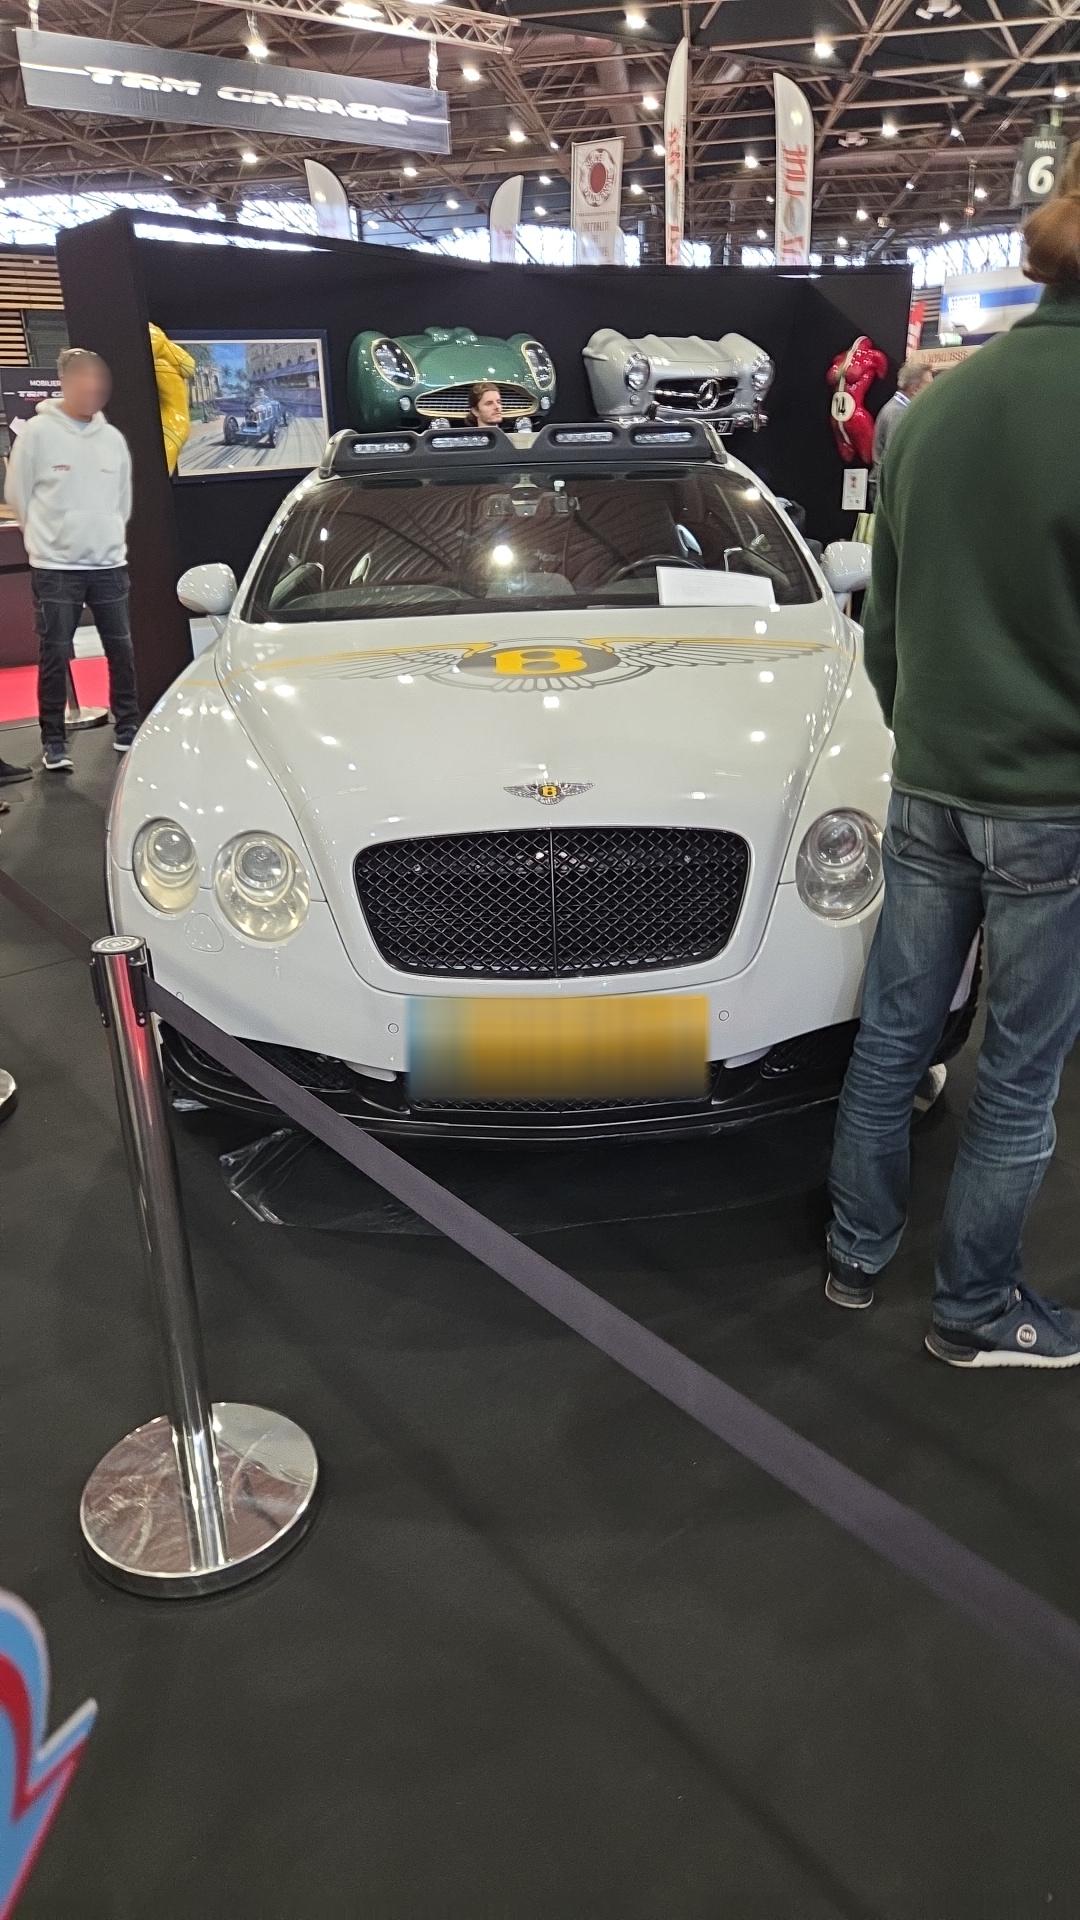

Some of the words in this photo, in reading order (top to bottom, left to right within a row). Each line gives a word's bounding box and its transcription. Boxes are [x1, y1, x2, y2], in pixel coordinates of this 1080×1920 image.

[217, 86, 409, 125] GARAGE
[1028, 156, 1055, 194] 6
[492, 649, 587, 675] B
[543, 785, 558, 798] B
